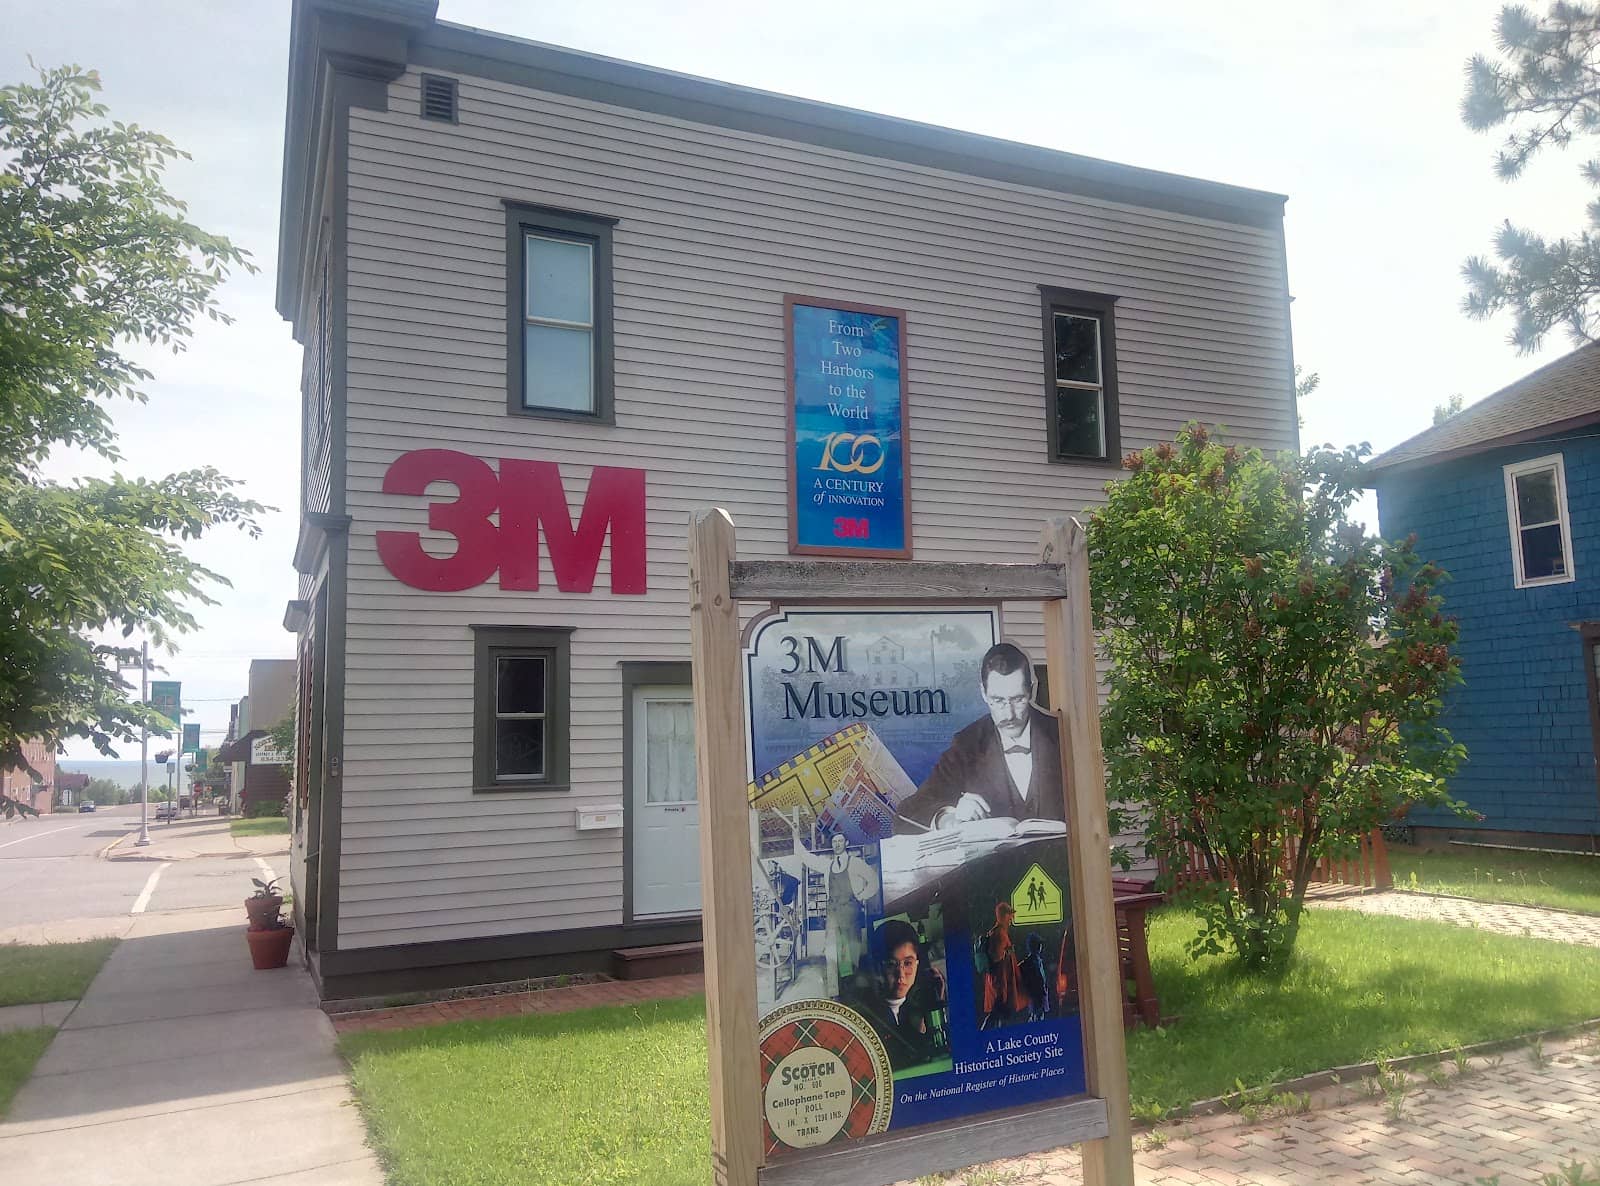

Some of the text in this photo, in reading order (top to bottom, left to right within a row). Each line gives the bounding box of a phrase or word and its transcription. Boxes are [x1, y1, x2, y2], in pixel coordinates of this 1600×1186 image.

[829, 319, 864, 337] From
[832, 341, 862, 357] Two
[821, 360, 874, 380] Harbors
[829, 384, 867, 399] to the
[827, 403, 869, 420] World
[812, 431, 885, 474] 100
[813, 477, 884, 493] A CENTURY
[813, 491, 885, 507] of INNOVATION
[376, 448, 647, 595] 3M
[833, 517, 870, 539] 3M
[780, 635, 847, 675] 3M
[781, 681, 950, 720] Museum
[986, 1031, 1059, 1053] A Lake County
[955, 1046, 1064, 1074] Historical Society Site
[900, 1066, 1065, 1104] On the National Register of Historic Places
[773, 1089, 846, 1108] Cellophane Tape
[805, 1103, 823, 1113] ROLL
